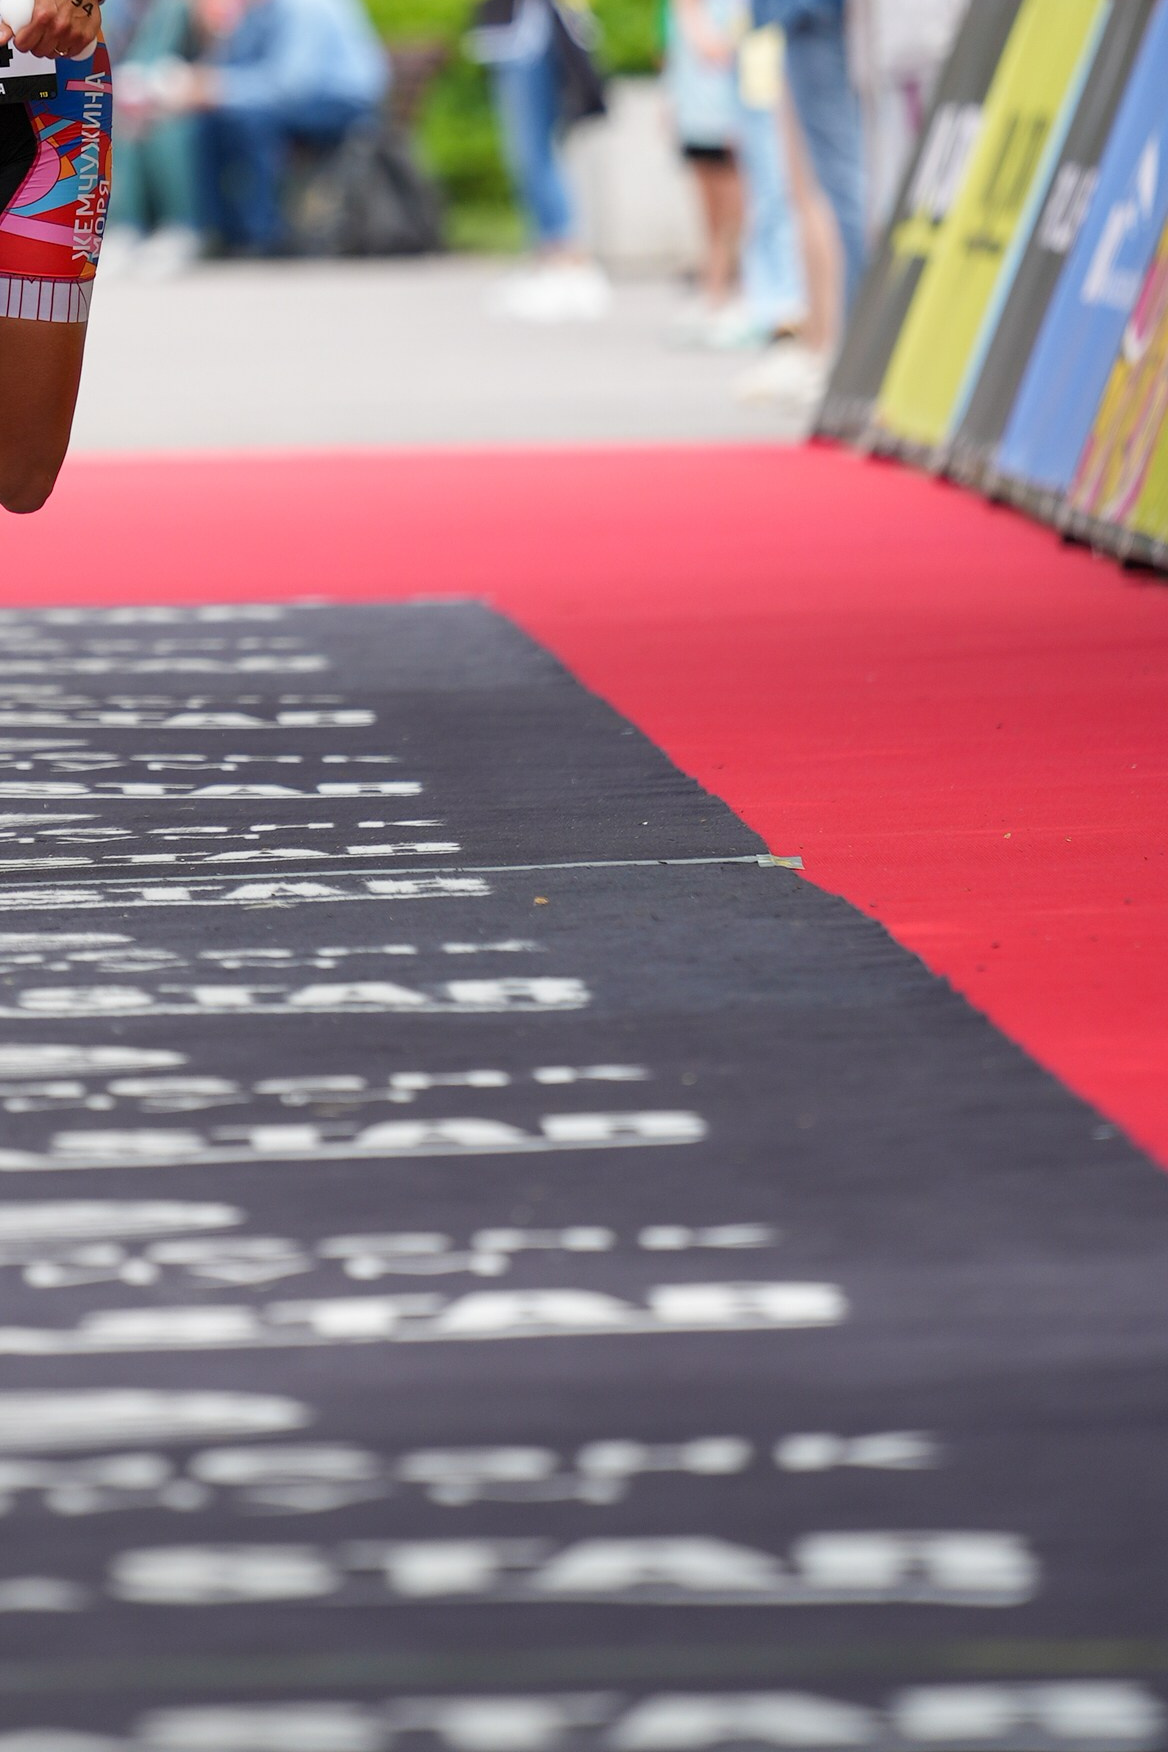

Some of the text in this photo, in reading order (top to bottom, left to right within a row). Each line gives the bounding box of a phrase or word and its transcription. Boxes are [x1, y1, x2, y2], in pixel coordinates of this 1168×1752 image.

[71, 71, 106, 262] ЖЕМЧУЖИНА
[89, 179, 110, 259] МОРЯ
[14, 976, 592, 1011] STAR
